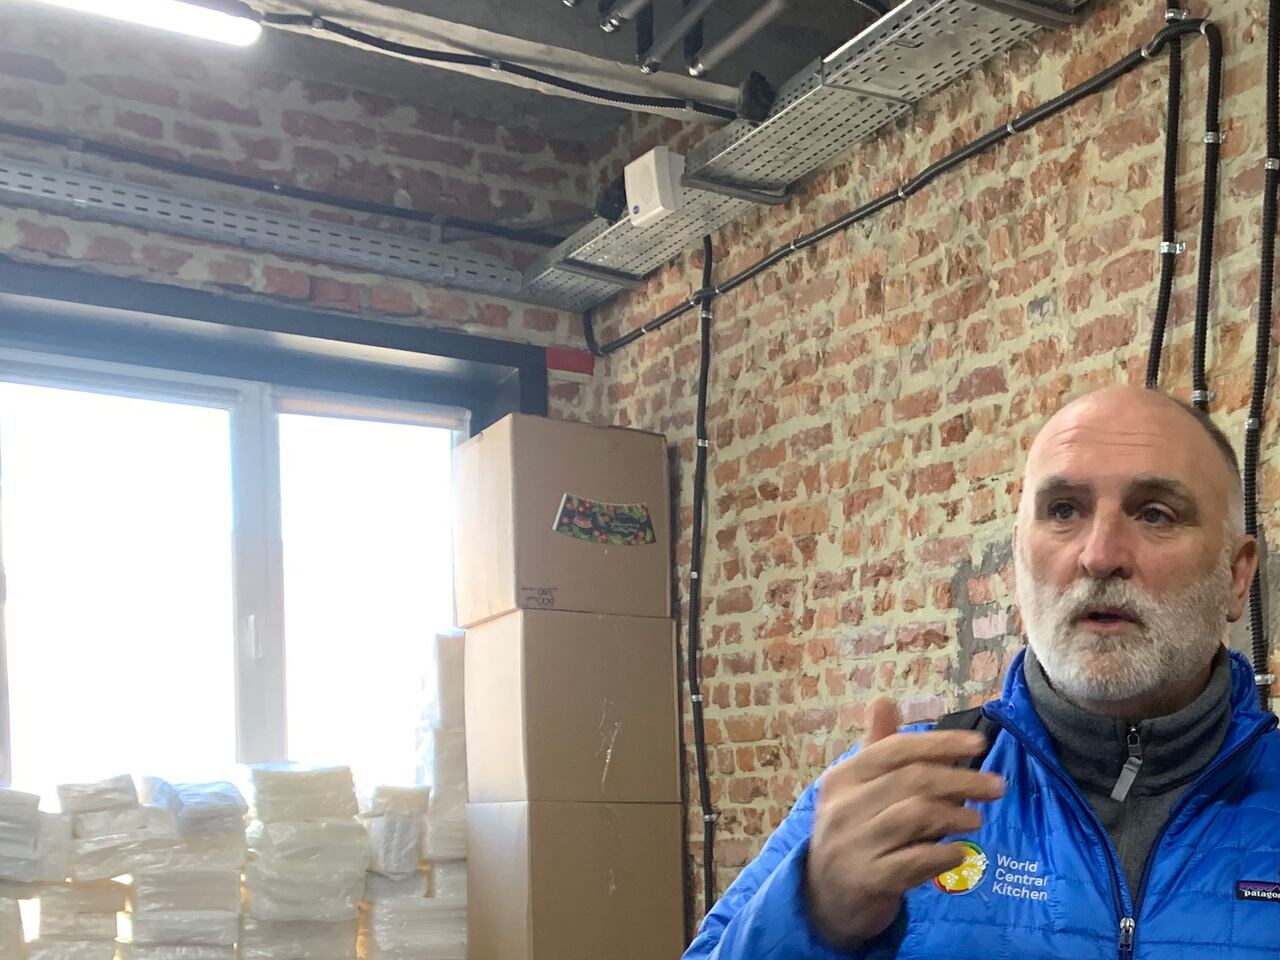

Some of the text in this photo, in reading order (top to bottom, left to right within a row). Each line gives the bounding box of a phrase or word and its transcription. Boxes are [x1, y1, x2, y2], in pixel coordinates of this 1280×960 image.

[996, 853, 1039, 873] World
[995, 868, 1048, 887] Central
[992, 882, 1048, 901] Kitchen
